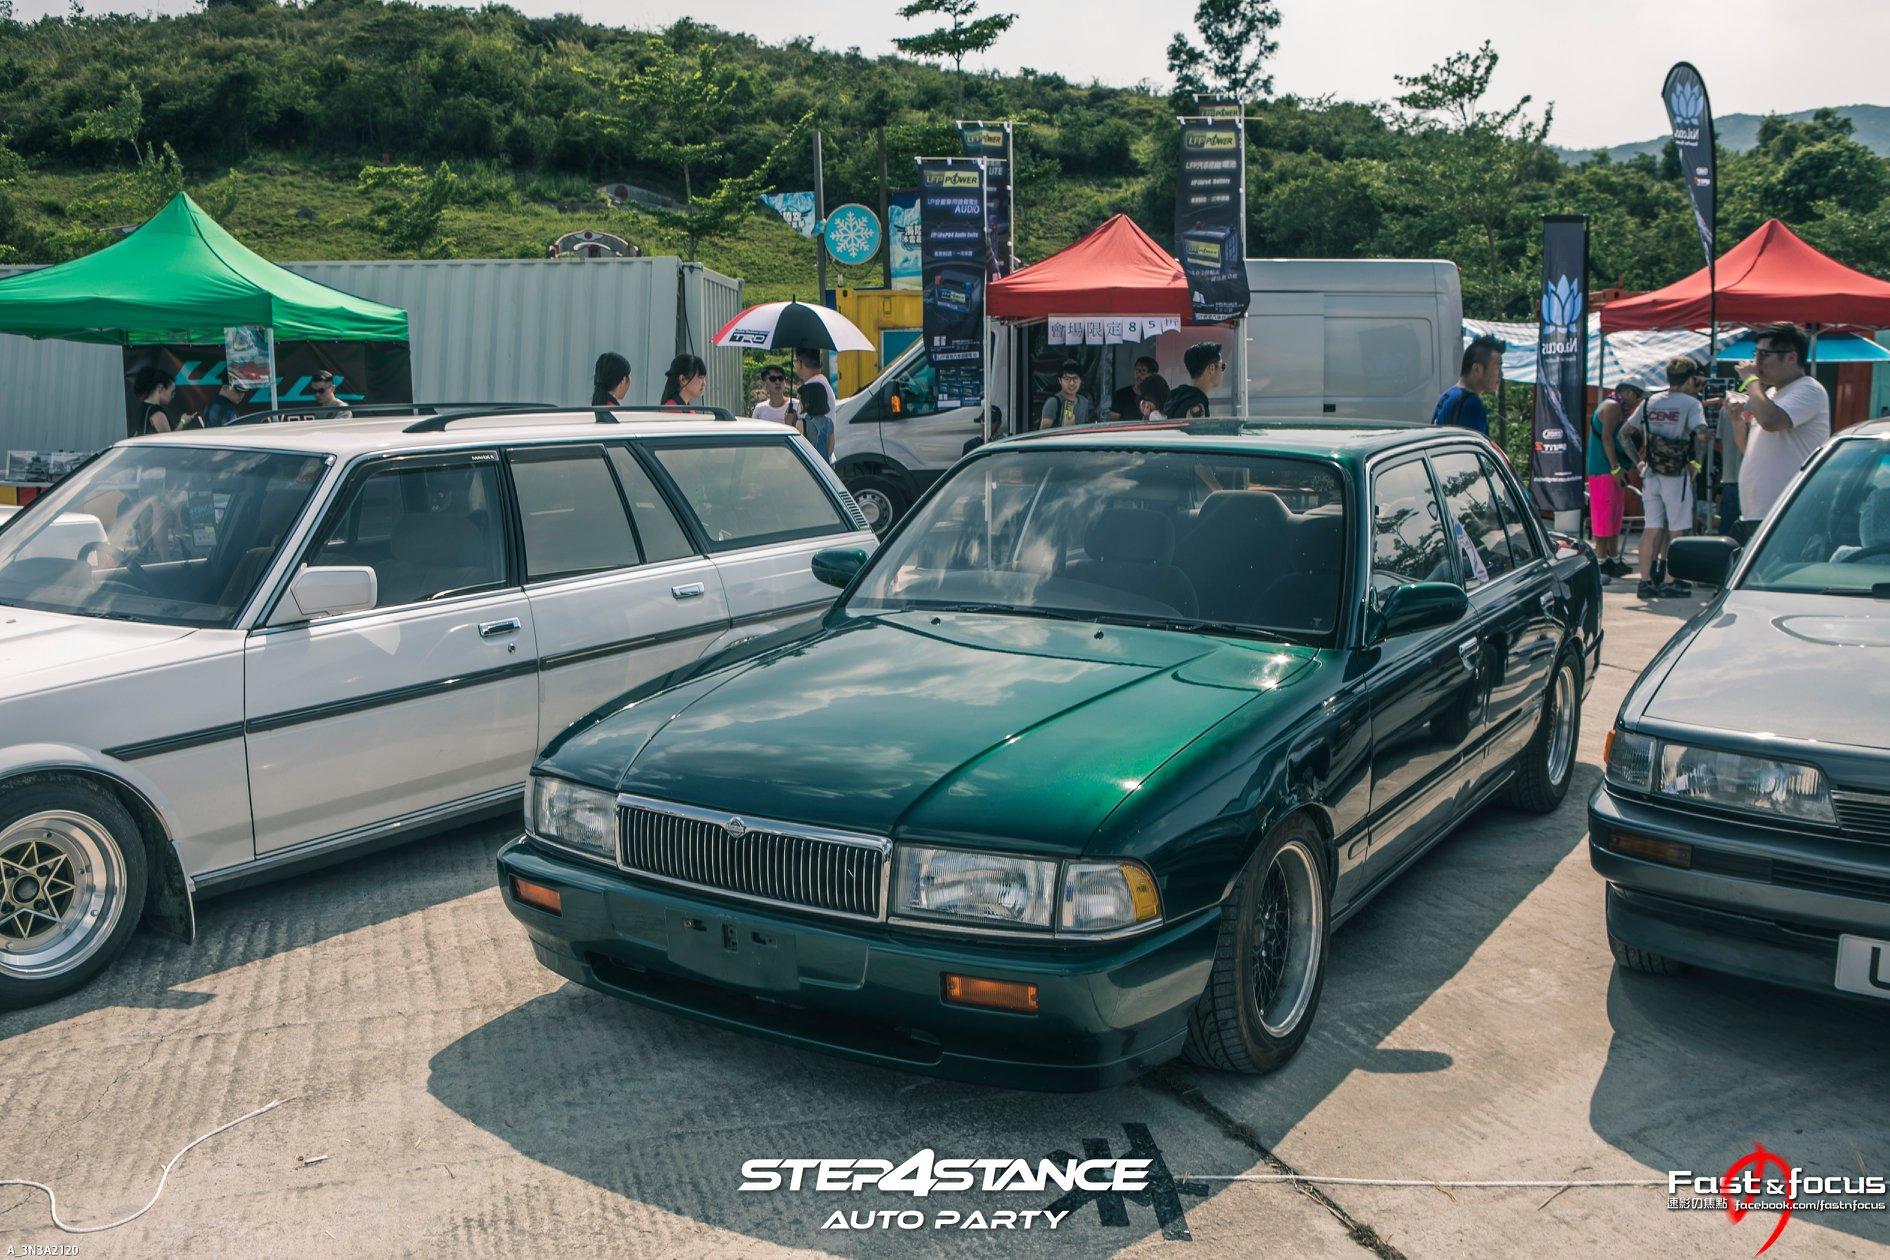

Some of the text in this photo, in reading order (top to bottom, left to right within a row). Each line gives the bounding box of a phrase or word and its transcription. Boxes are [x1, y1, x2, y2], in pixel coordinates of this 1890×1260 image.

[1206, 133, 1233, 146] POWER
[945, 173, 978, 185] POWER
[954, 205, 981, 214] AUDIO
[732, 333, 767, 344] TRD
